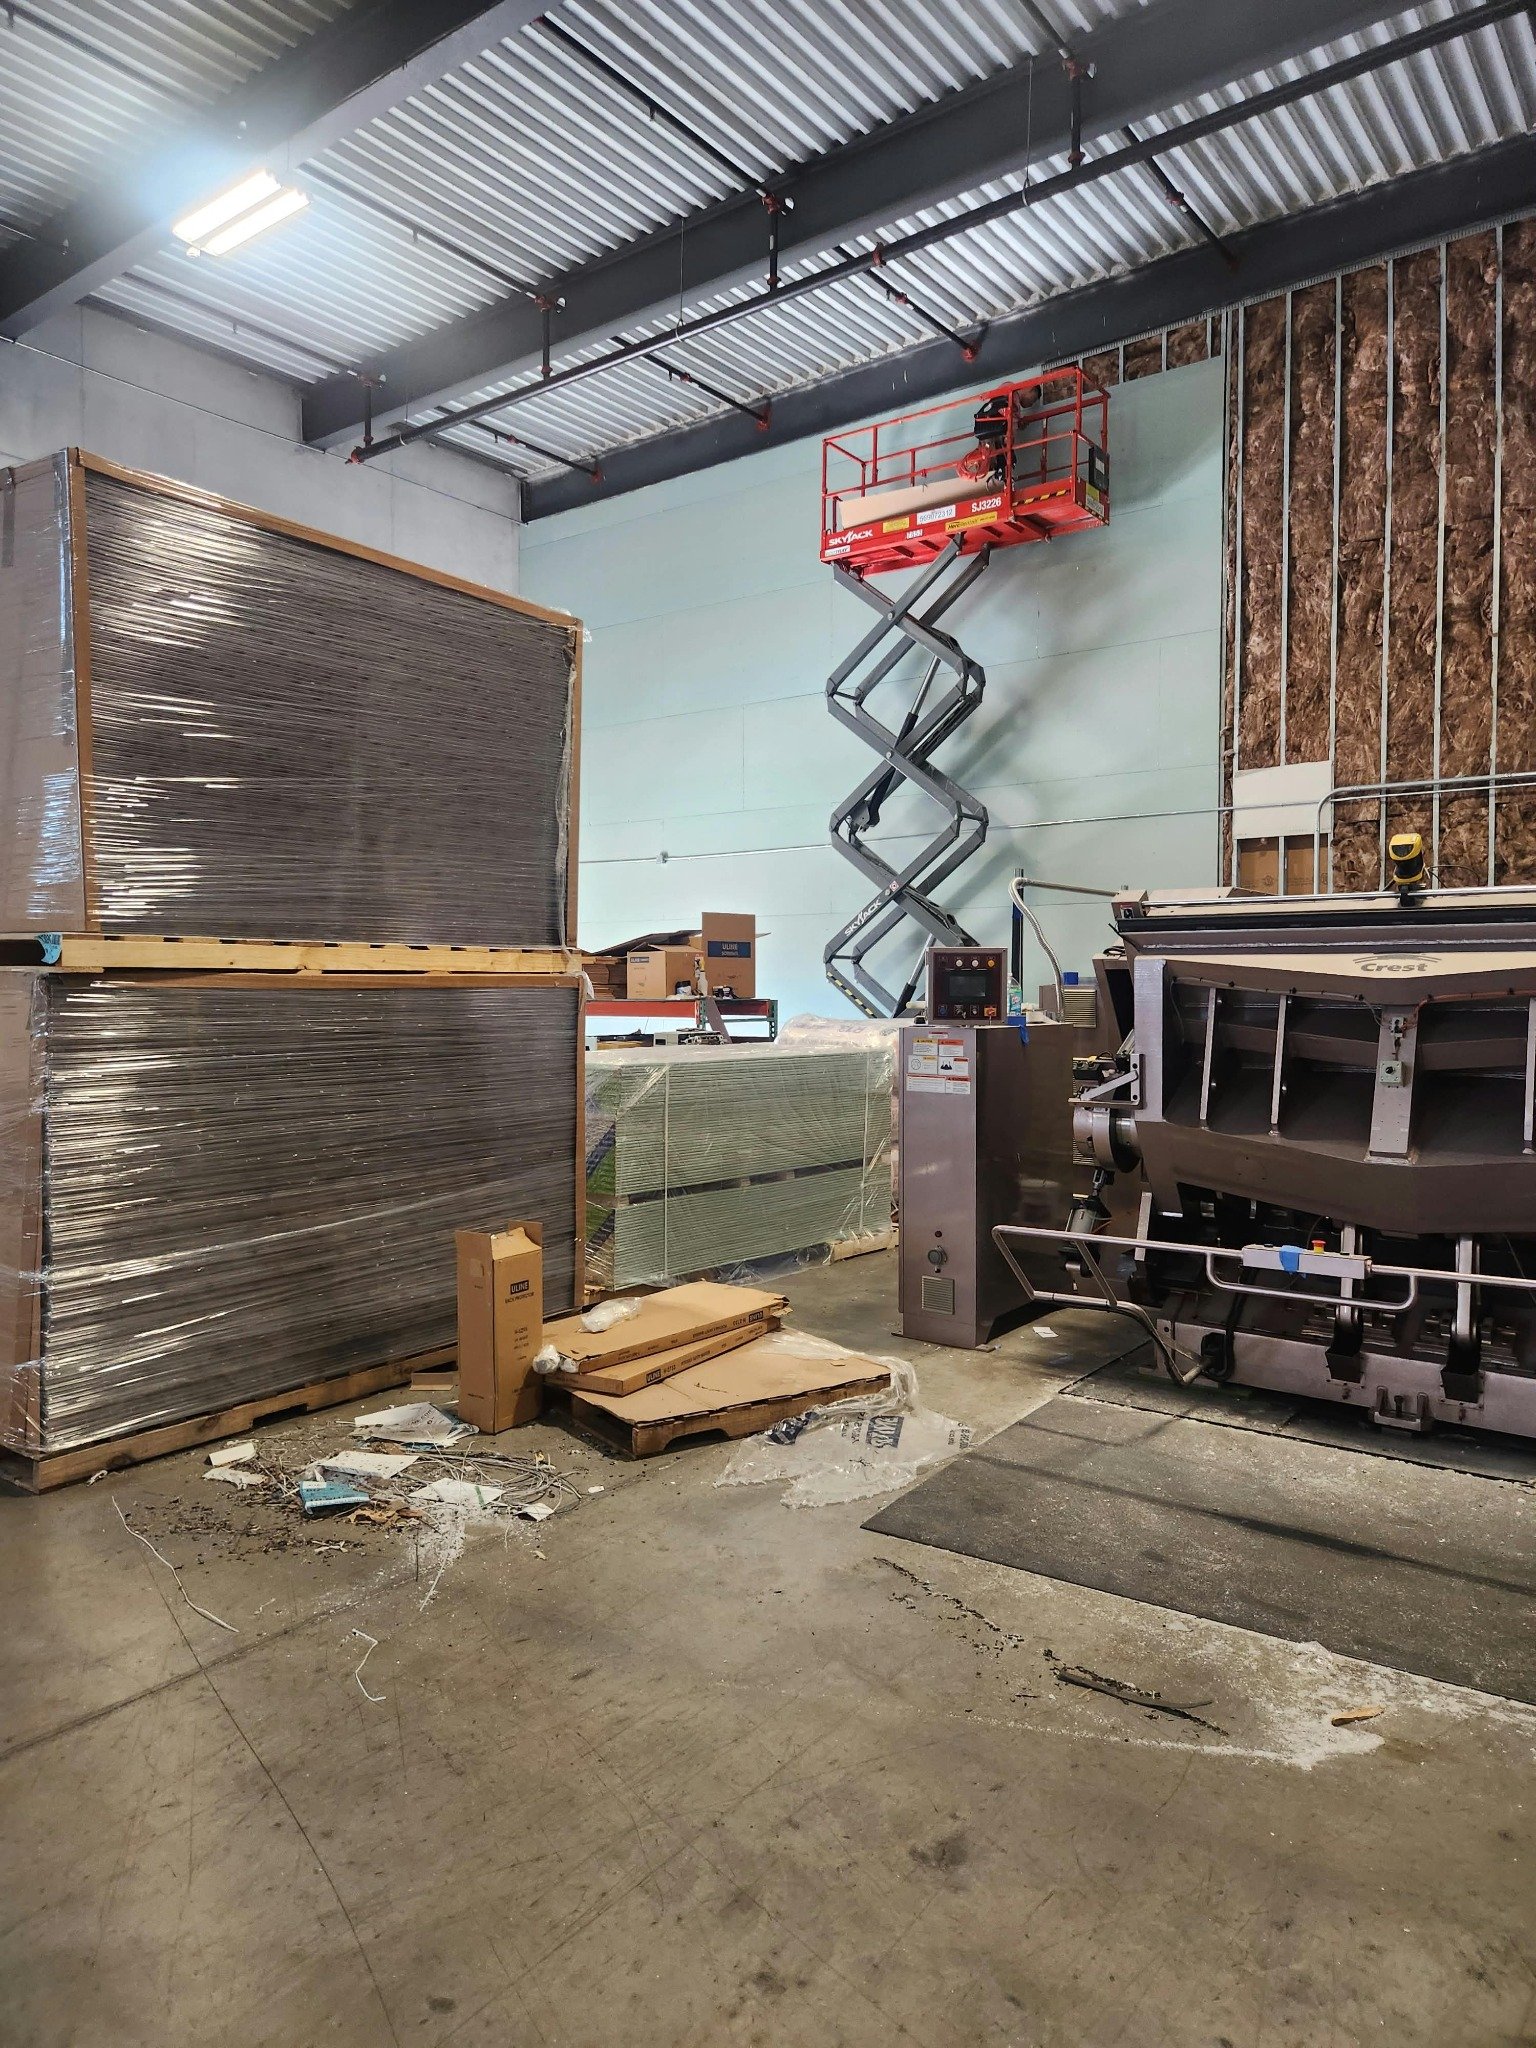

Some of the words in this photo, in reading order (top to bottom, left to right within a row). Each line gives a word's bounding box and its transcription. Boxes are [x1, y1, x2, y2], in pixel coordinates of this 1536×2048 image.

[971, 497, 1002, 513] SJ3226
[828, 529, 874, 546] SKYJACK
[844, 899, 882, 937] SKYJACK
[1360, 963, 1428, 972] Crest
[511, 1281, 529, 1294] ULINE
[749, 1311, 763, 1323] ULINE
